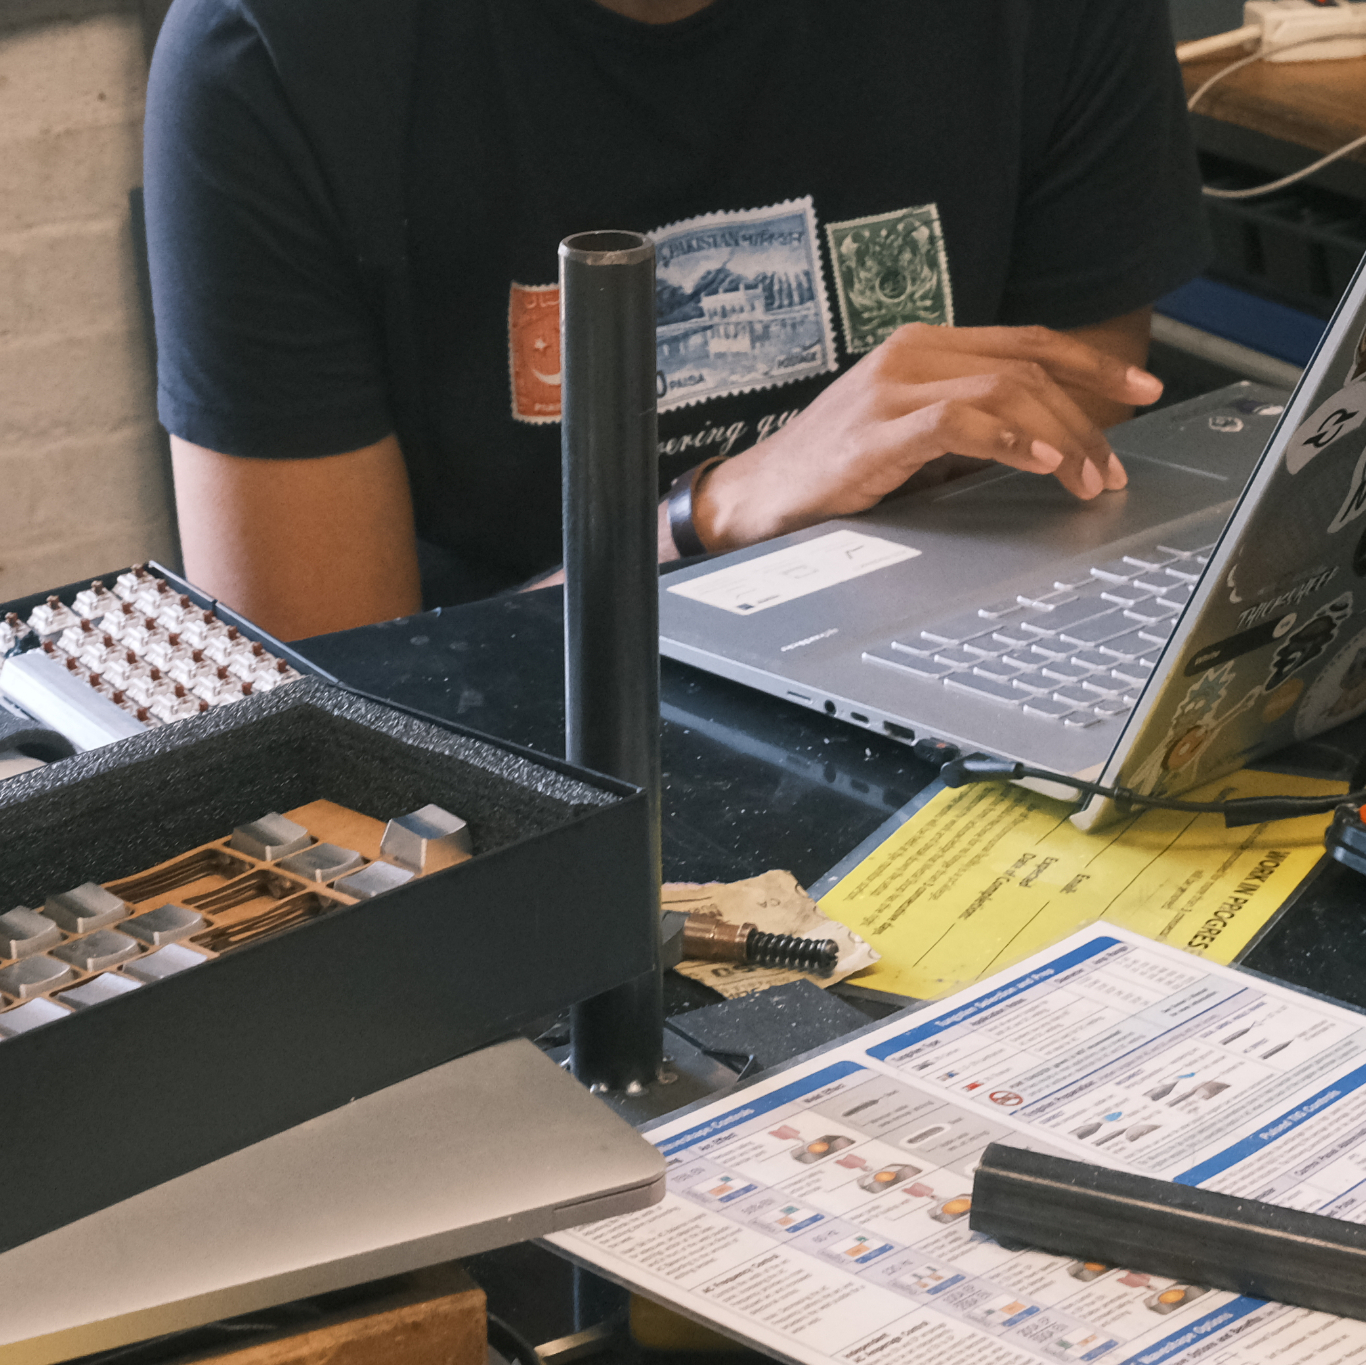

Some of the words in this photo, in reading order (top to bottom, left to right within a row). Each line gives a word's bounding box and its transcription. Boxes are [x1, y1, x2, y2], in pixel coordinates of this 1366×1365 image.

[1246, 850, 1289, 882] WORK
[1233, 882, 1260, 895] IN
[974, 987, 1017, 1008] Selection
[1015, 977, 1034, 988] and
[1030, 968, 1055, 980] Prep
[1259, 1120, 1293, 1140] Pulsed
[1302, 1090, 1341, 1112] Controls
[1193, 1312, 1233, 1334] Options
